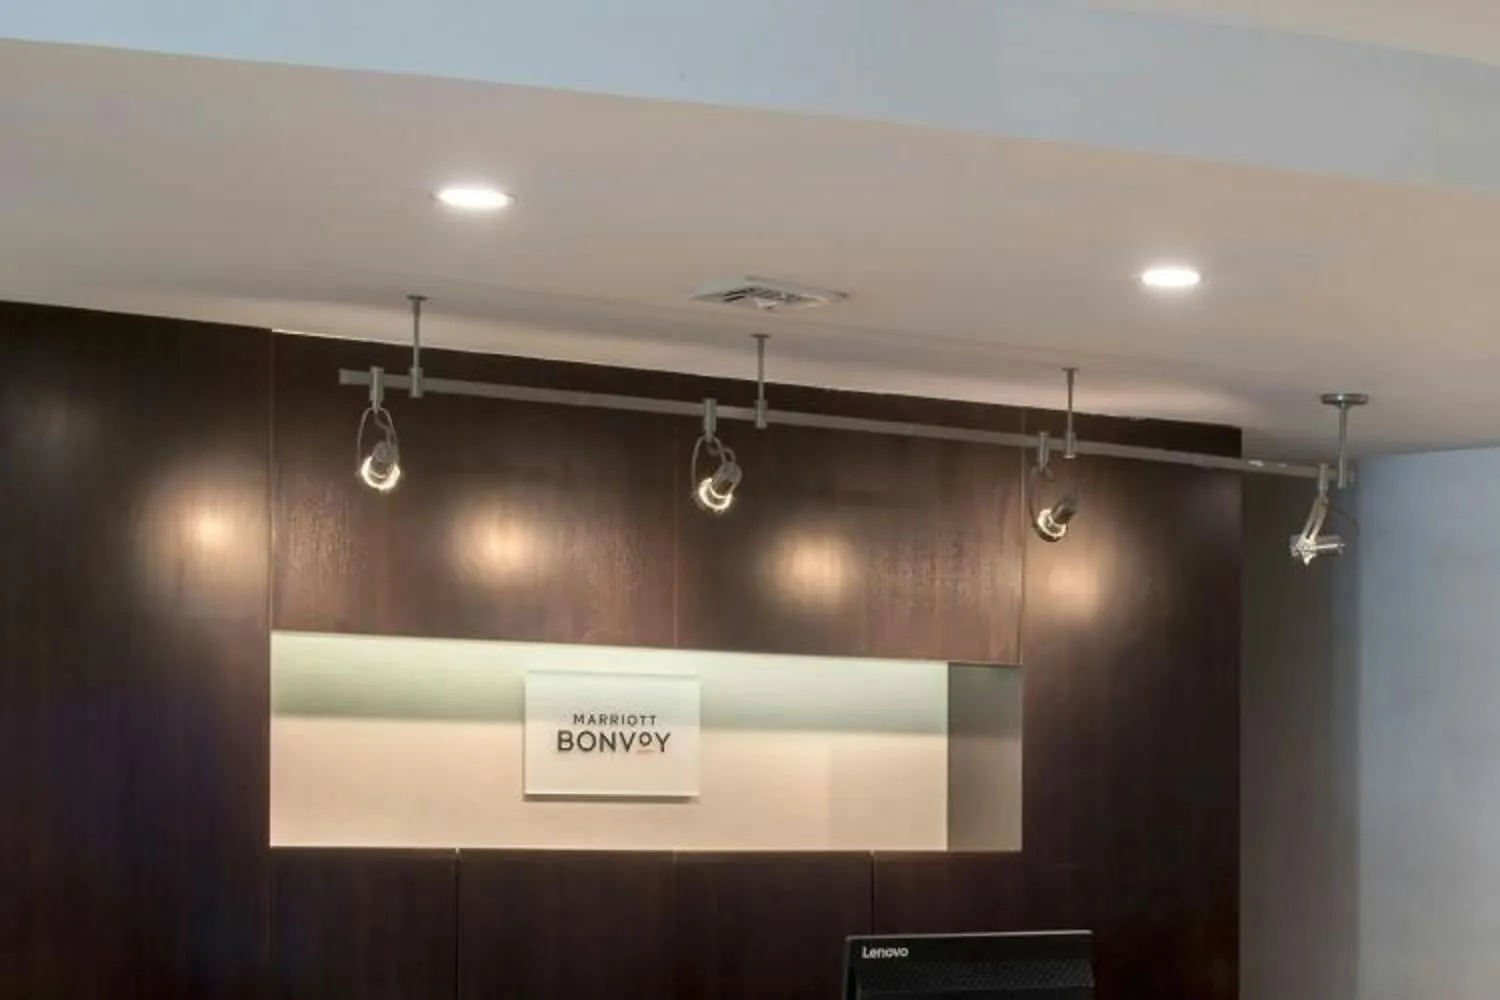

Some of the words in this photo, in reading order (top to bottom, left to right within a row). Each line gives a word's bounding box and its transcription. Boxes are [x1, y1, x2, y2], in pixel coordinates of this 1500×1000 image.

[572, 712, 657, 727] MARRIOTT
[557, 729, 671, 753] BONVOY
[862, 945, 909, 959] Lenovo
